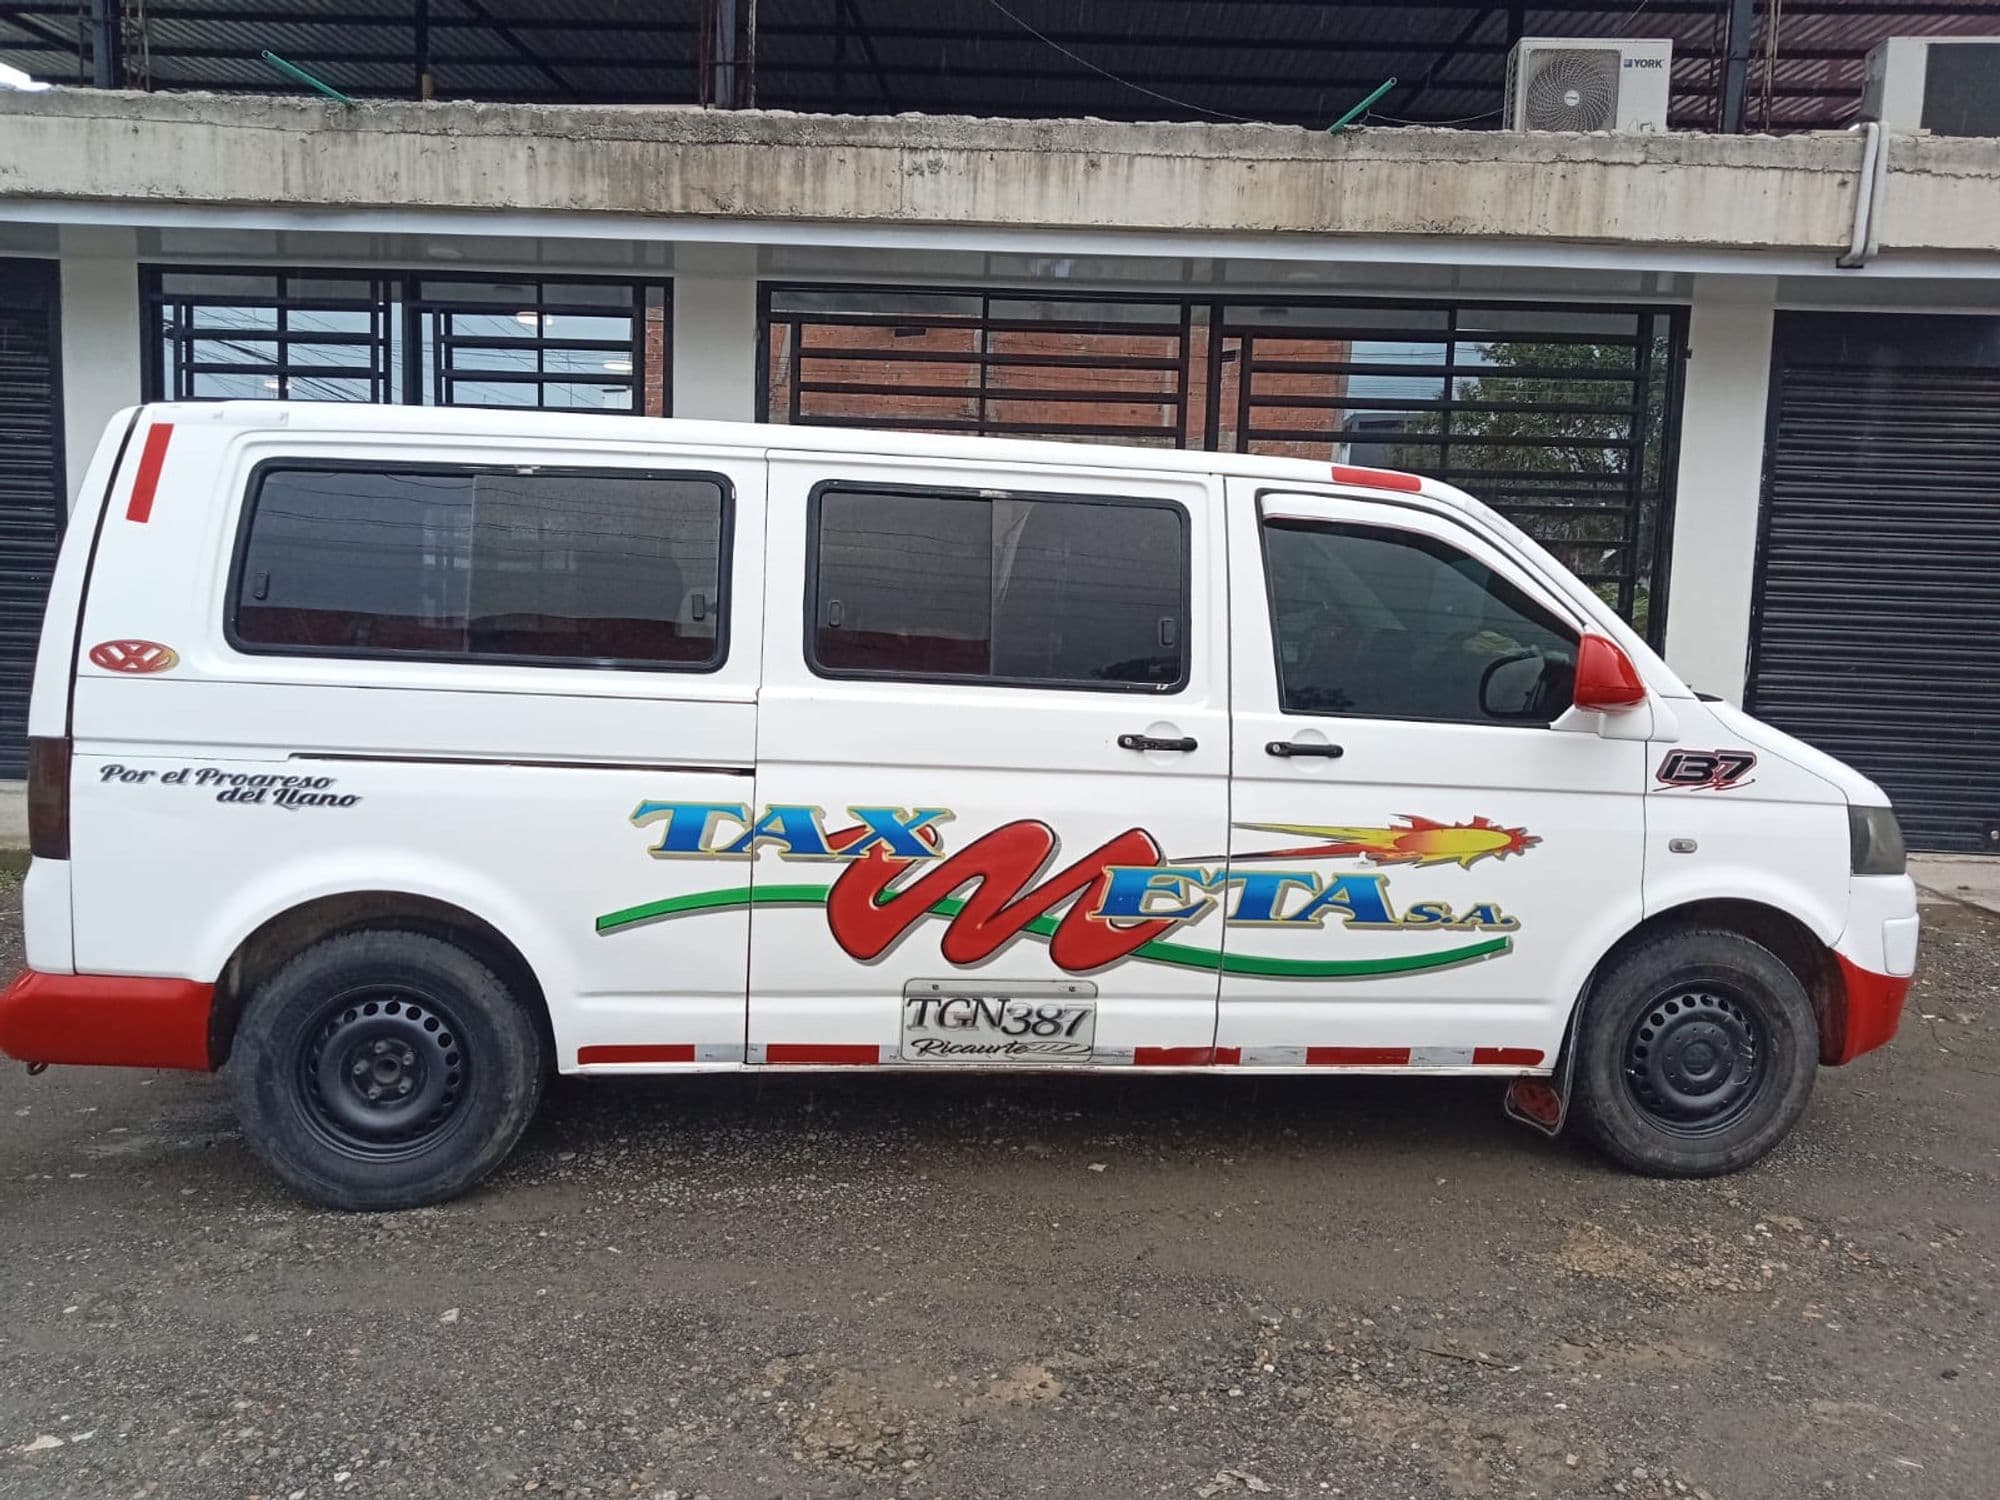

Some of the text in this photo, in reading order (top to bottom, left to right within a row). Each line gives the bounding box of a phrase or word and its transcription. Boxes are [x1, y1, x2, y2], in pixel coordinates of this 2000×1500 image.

[1633, 58, 1663, 69] YORK
[99, 763, 338, 789] Por el Progreso
[1656, 749, 1757, 785] 137
[216, 787, 364, 811] del Llano
[629, 799, 957, 862] TAX
[1401, 901, 1522, 931] S.A.
[905, 997, 1094, 1037] TGN387
[910, 1037, 1030, 1059] Ricaurte
